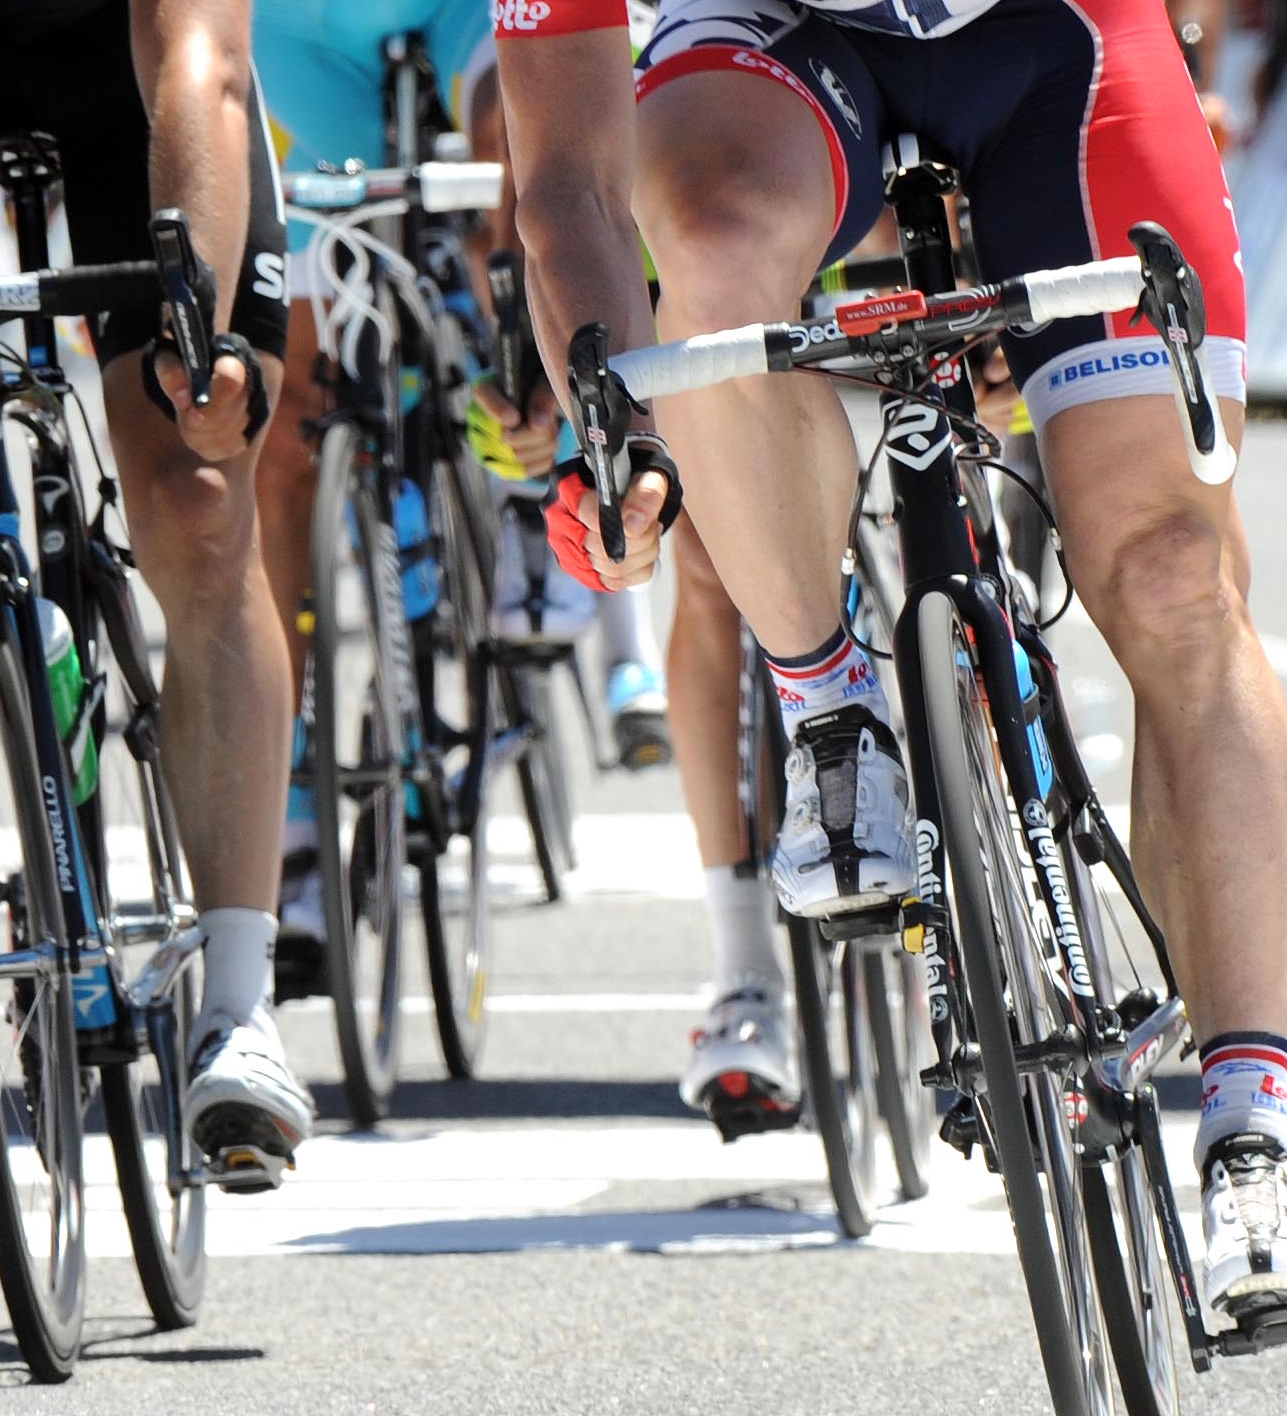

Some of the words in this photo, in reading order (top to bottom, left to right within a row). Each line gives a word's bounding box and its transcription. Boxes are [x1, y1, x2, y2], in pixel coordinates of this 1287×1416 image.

[845, 298, 909, 322] www.SRM.de
[43, 775, 76, 893] PINARELLO
[1027, 826, 1095, 998] Continental
